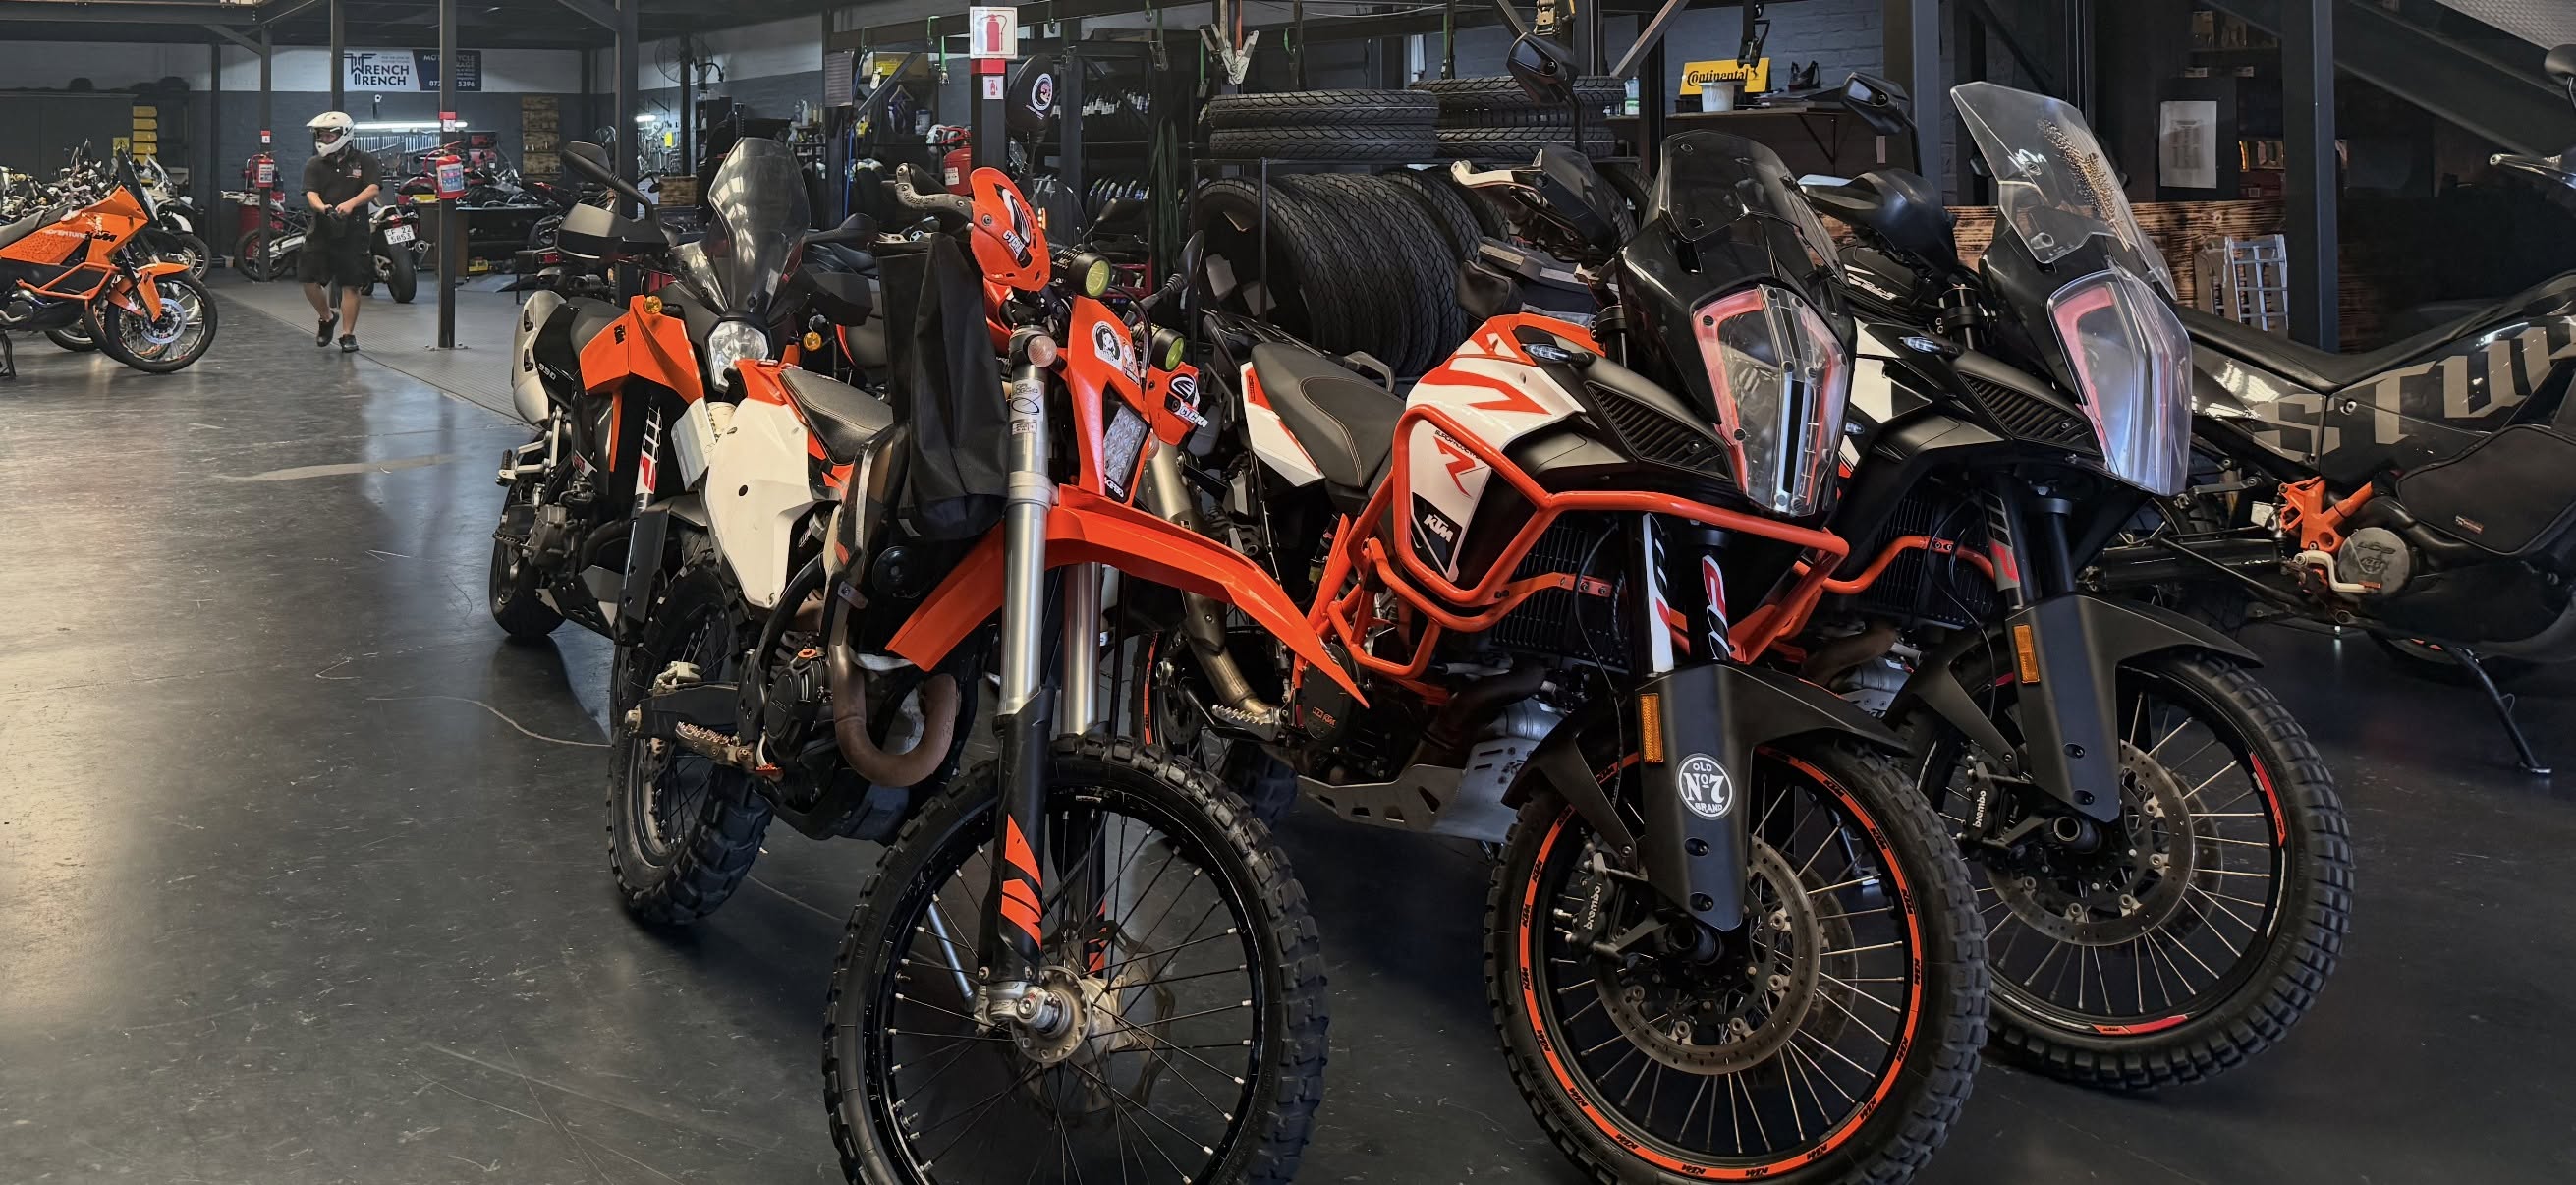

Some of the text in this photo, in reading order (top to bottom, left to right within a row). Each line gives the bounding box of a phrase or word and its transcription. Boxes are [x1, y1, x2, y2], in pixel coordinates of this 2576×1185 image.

[1687, 66, 1749, 86] Continental
[537, 363, 557, 380] 990
[1423, 513, 1454, 542] KTM
[1692, 762, 1712, 772] OLD
[1694, 802, 1722, 814] BRAND
[1972, 790, 1987, 828] brembo
[1583, 885, 1601, 930] brembo
